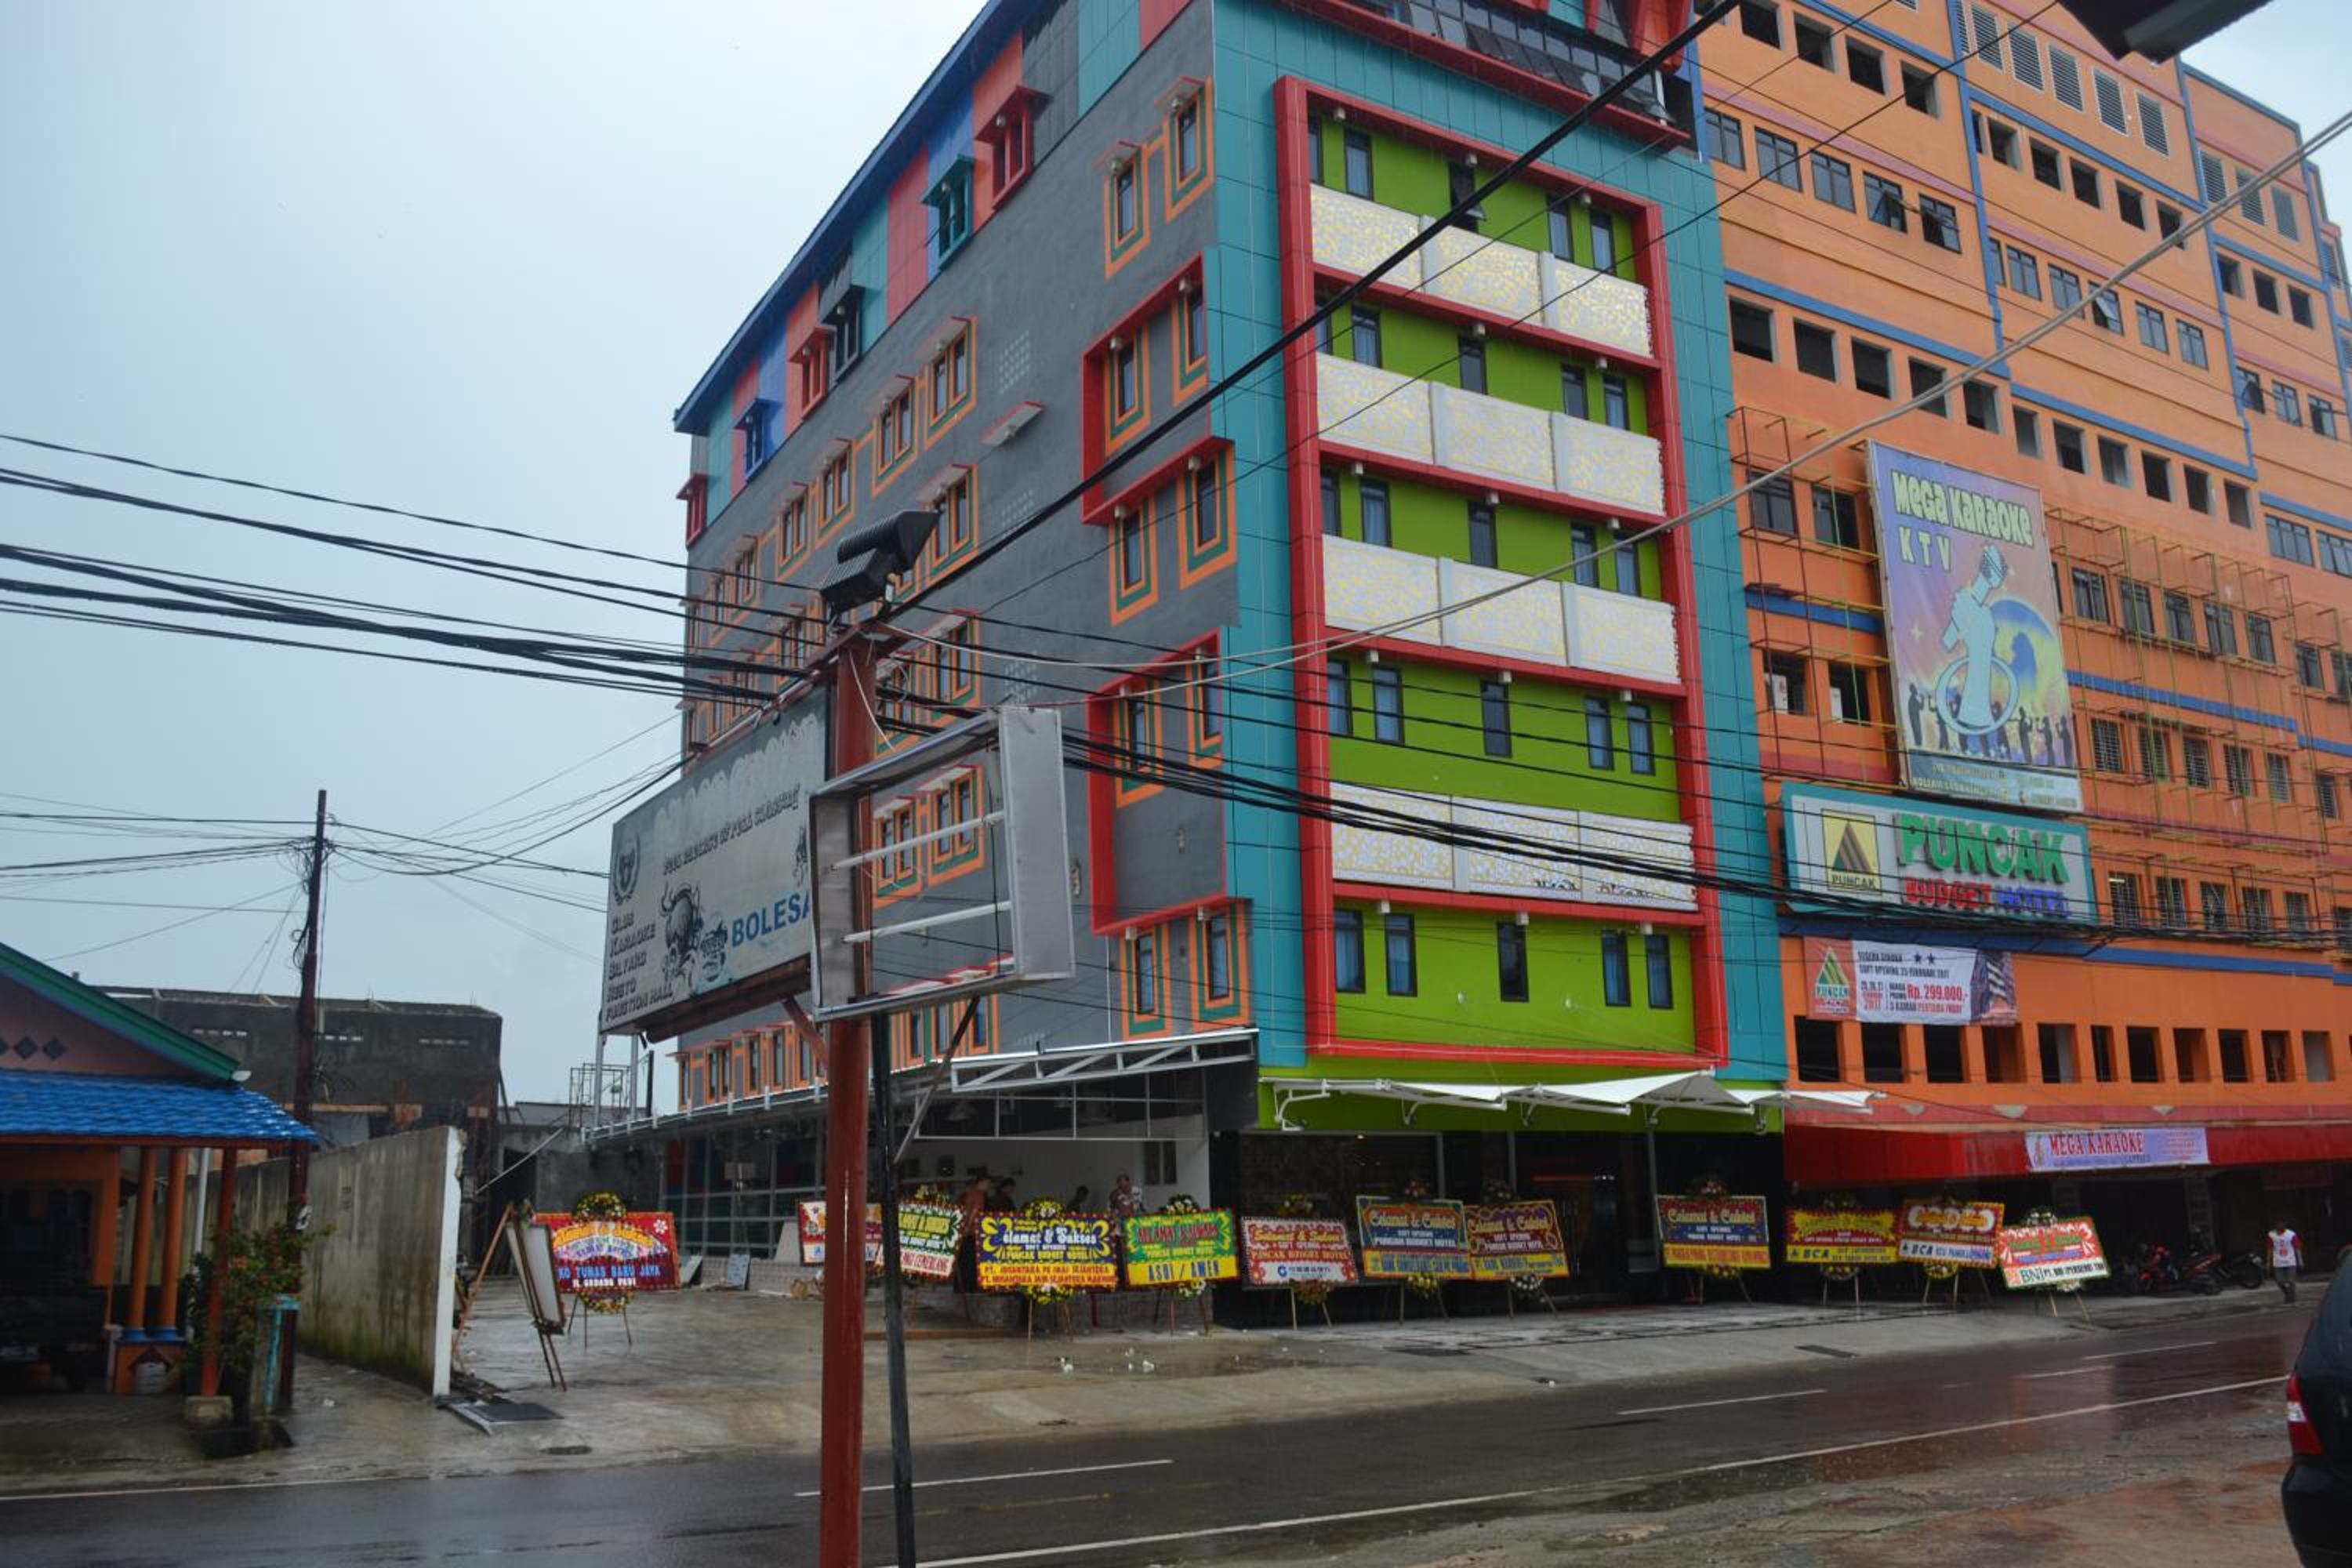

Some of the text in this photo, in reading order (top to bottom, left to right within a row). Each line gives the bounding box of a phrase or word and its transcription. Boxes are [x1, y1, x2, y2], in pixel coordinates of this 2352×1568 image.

[1897, 812, 2071, 884] PUNCAK
[1831, 873, 1878, 890] PUNCAK
[1906, 877, 1992, 909] BUDGET
[2049, 1133, 2084, 1156] MEGA
[2088, 1131, 2144, 1155] KARAOKE
[1803, 1248, 1831, 1258] BCA
[1911, 1244, 1933, 1255] BCA
[2020, 1267, 2045, 1283] BNI
